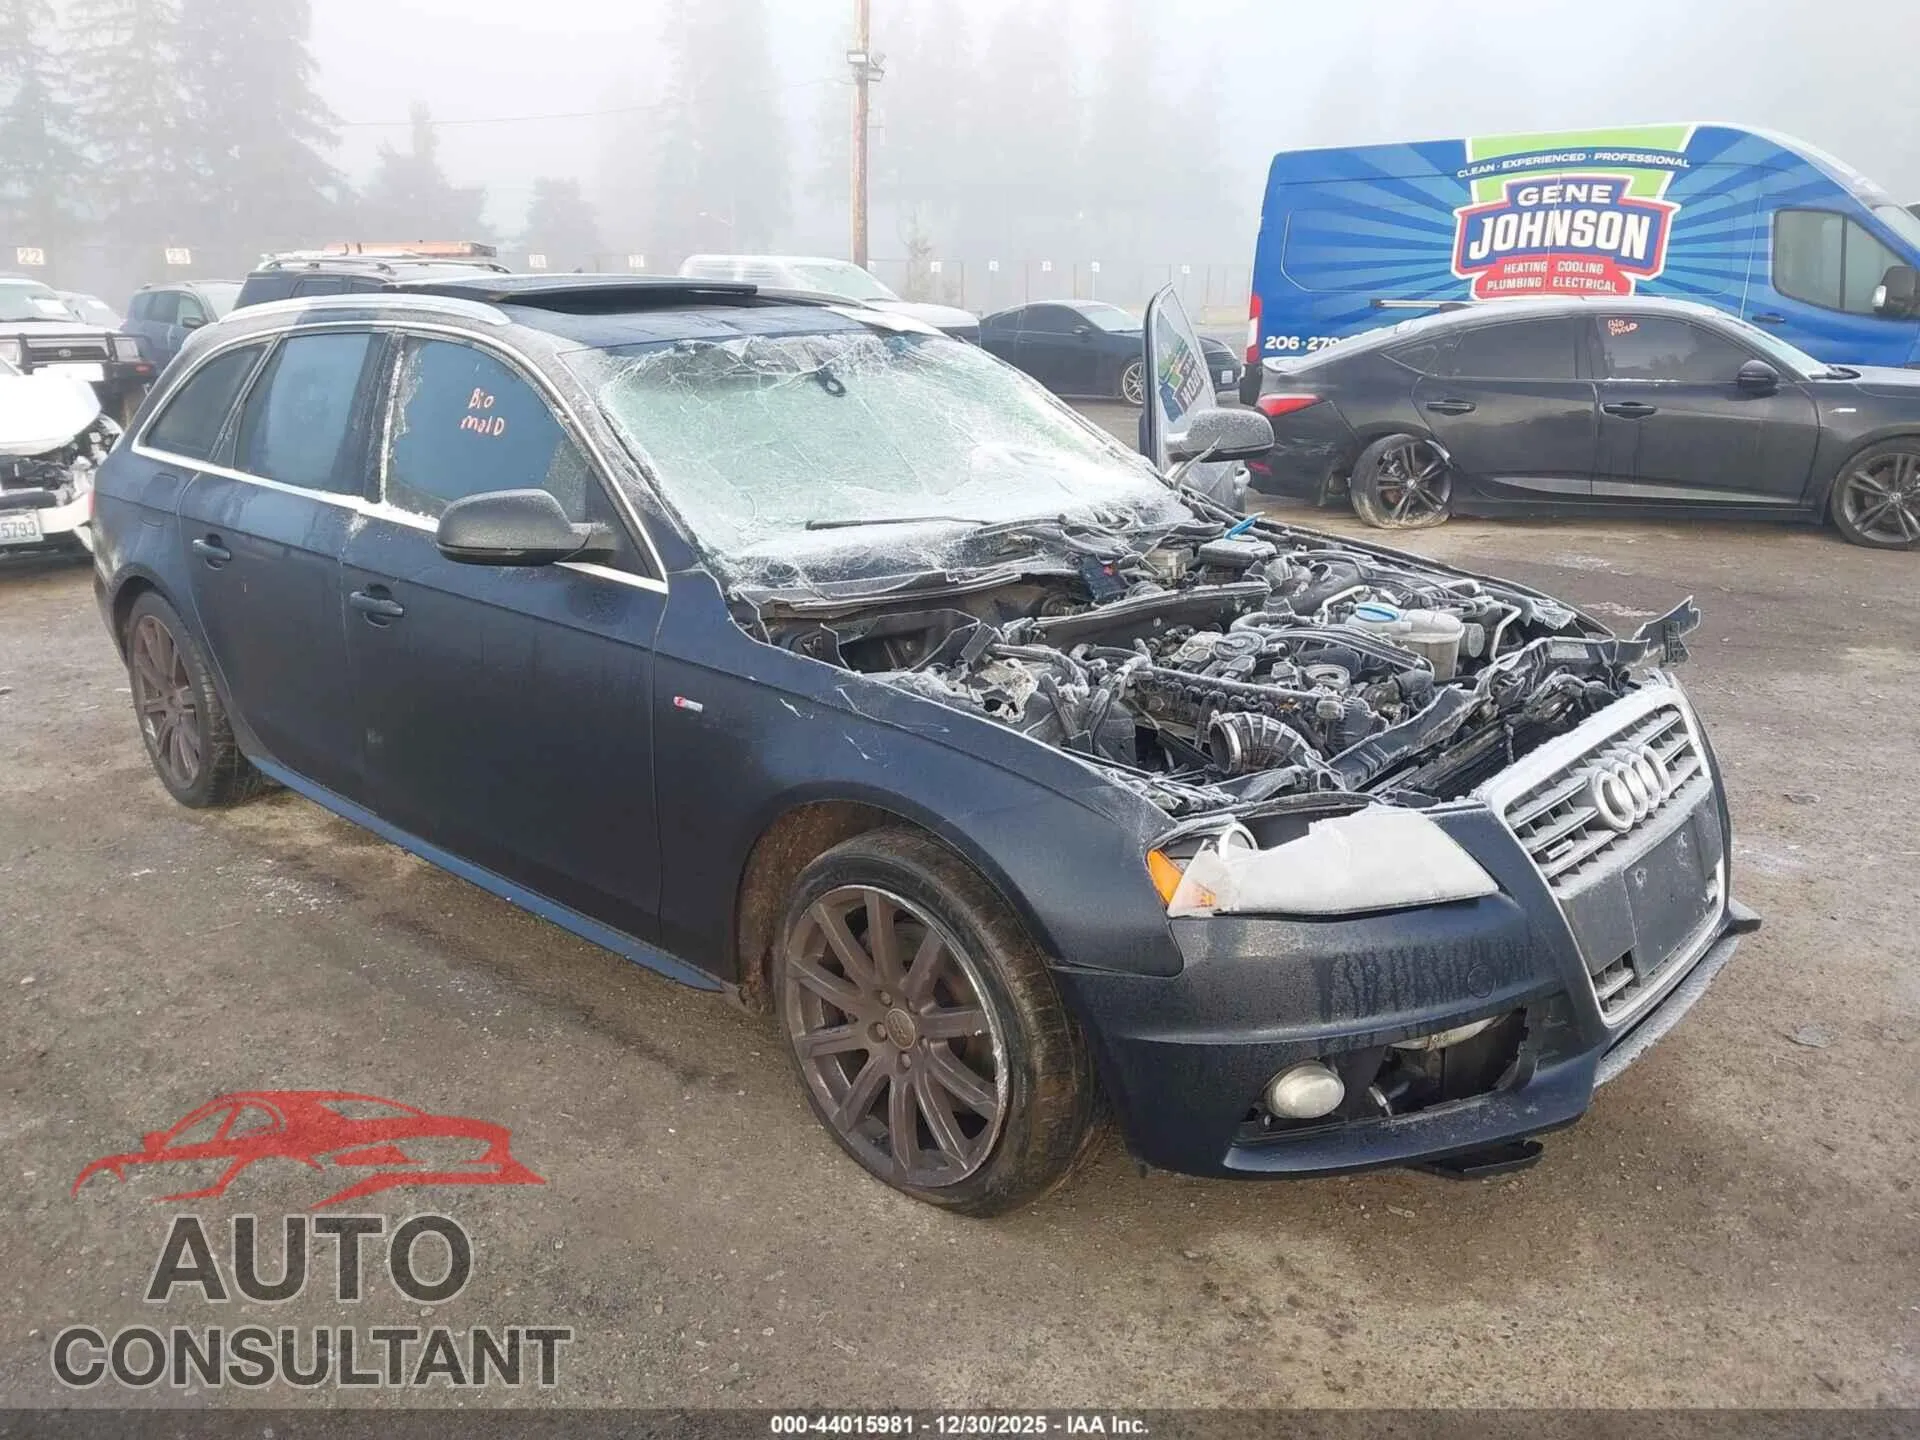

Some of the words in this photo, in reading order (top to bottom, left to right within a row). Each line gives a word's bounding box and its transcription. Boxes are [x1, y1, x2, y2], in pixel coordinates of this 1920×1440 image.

[1457, 163, 1495, 178] CLEAN
[1502, 152, 1587, 169] EXPERIENCED
[1594, 152, 1690, 168] PROFESSIONAL
[1517, 184, 1613, 207] GENE
[1468, 209, 1651, 260] JOHNSON
[1503, 261, 1548, 274] HEATING
[1557, 261, 1604, 274] COOLING
[1486, 277, 1542, 291] PLUMBING
[1552, 276, 1617, 293] ELECTRICAL
